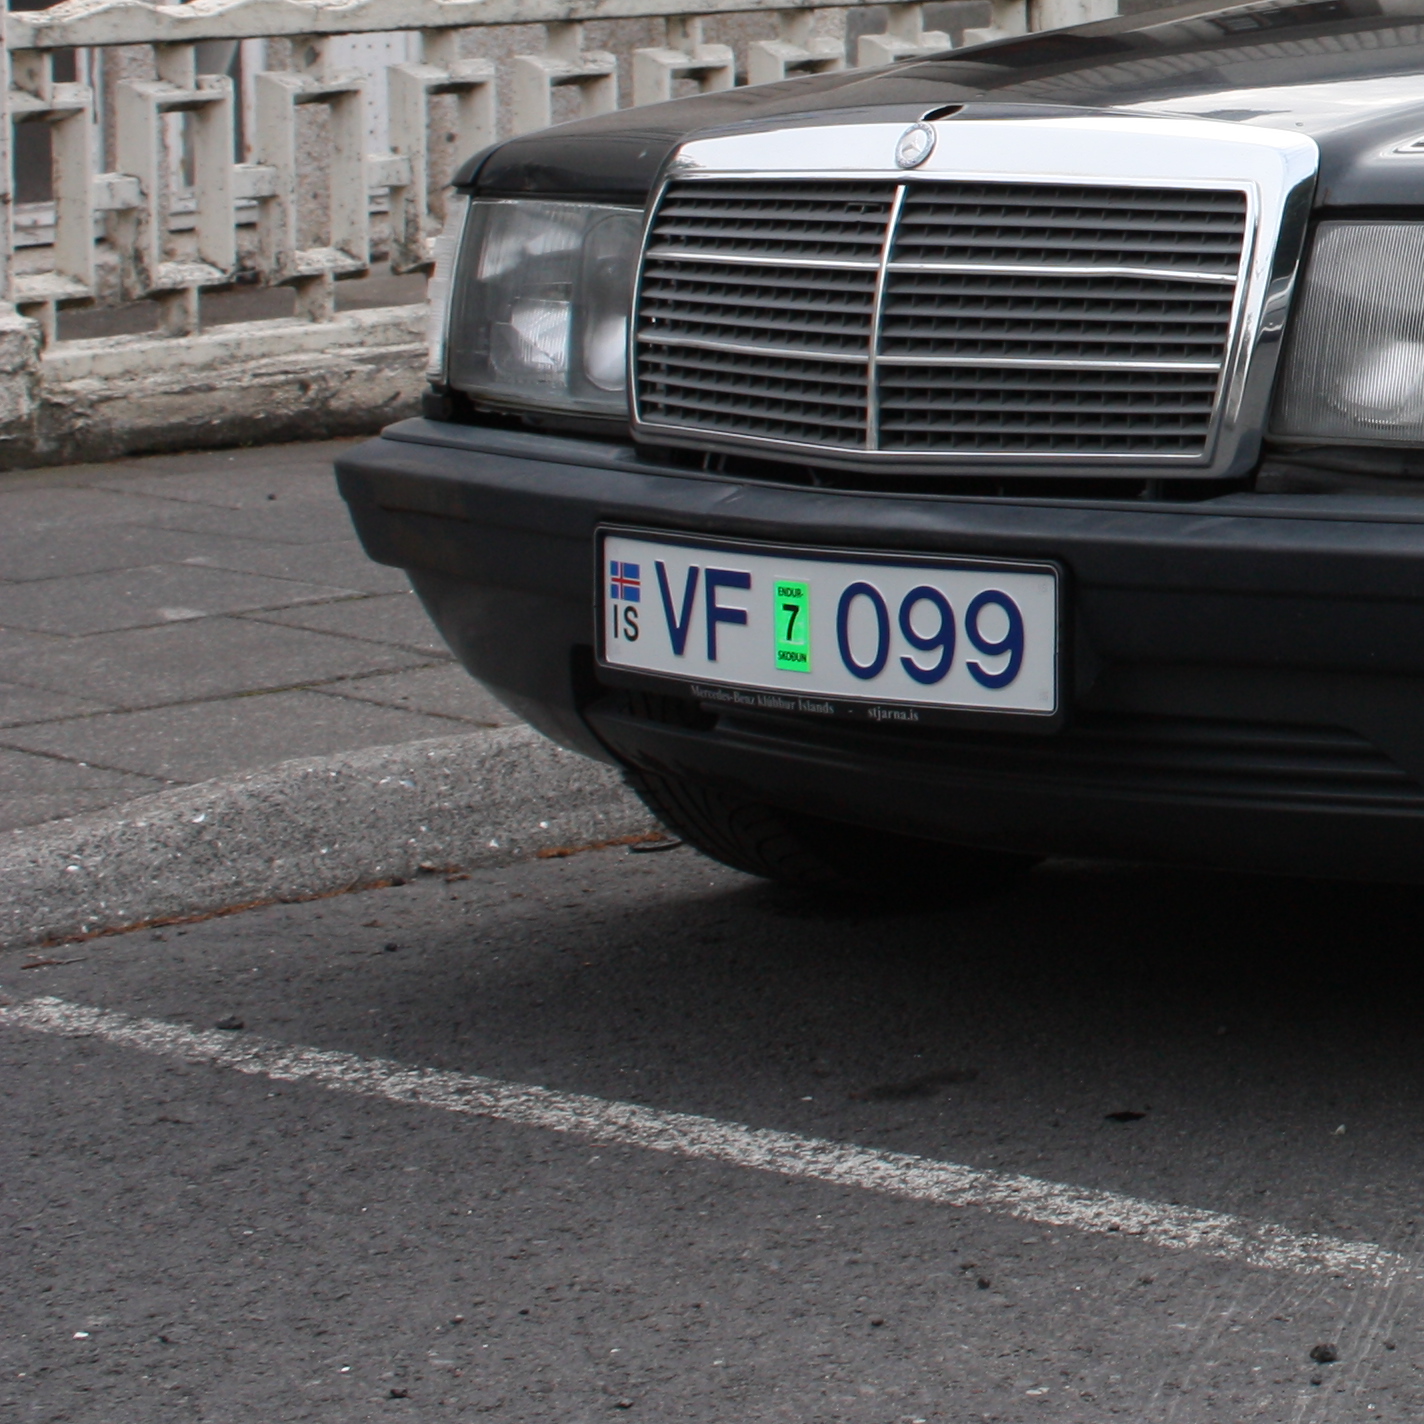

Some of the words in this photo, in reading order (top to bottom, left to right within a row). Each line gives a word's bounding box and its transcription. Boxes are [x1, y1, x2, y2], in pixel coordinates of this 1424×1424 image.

[613, 604, 639, 642] IS
[654, 559, 752, 661] VF
[836, 581, 1024, 690] 099
[782, 603, 800, 641] 7
[867, 707, 919, 722] stjarna.is
